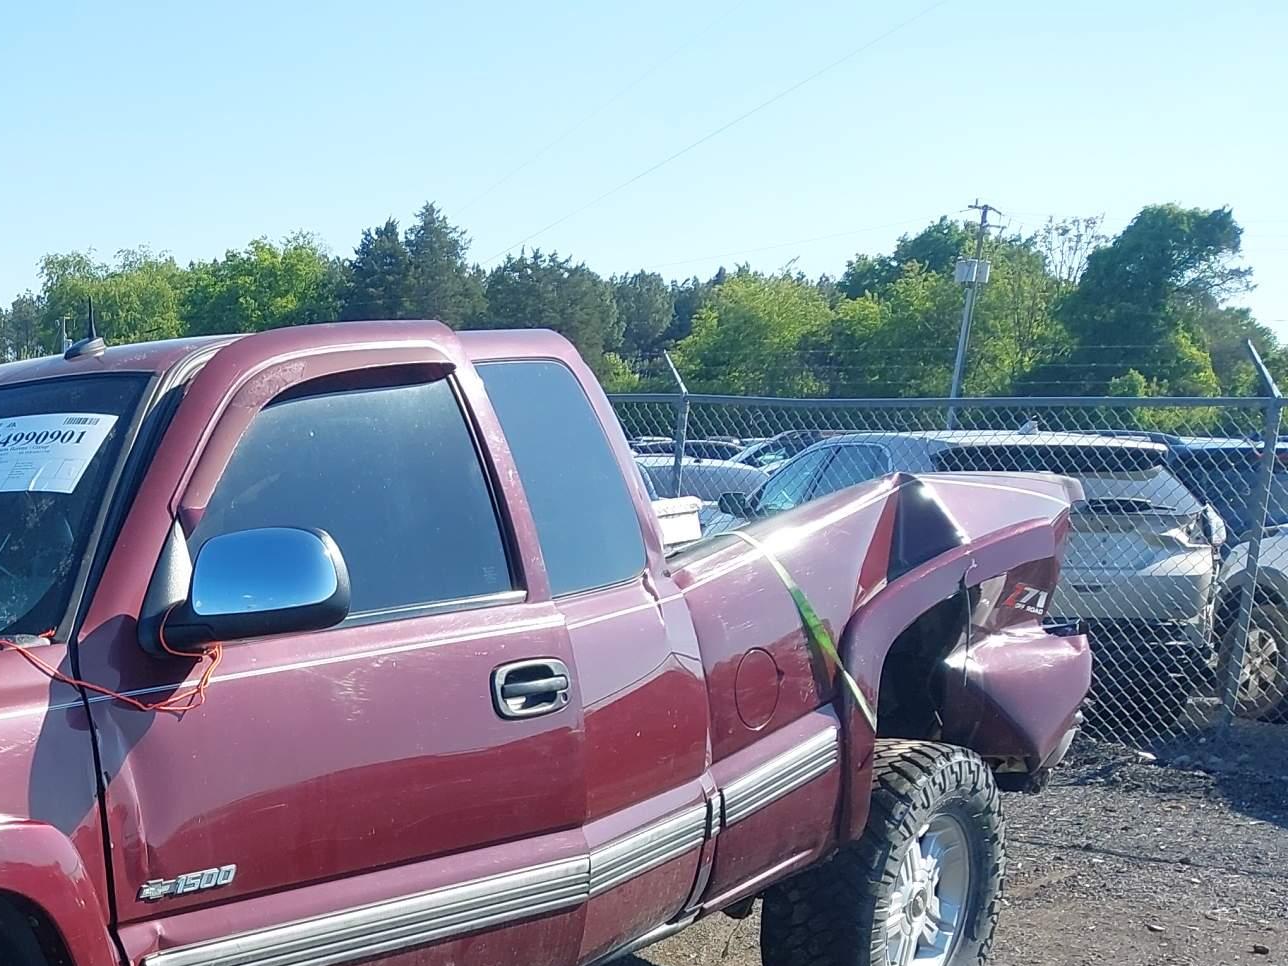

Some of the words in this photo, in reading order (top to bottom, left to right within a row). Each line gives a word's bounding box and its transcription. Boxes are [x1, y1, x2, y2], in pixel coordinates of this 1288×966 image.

[1003, 582, 1049, 609] Z71
[1026, 605, 1044, 615] ROAD
[175, 863, 238, 895] 1500
